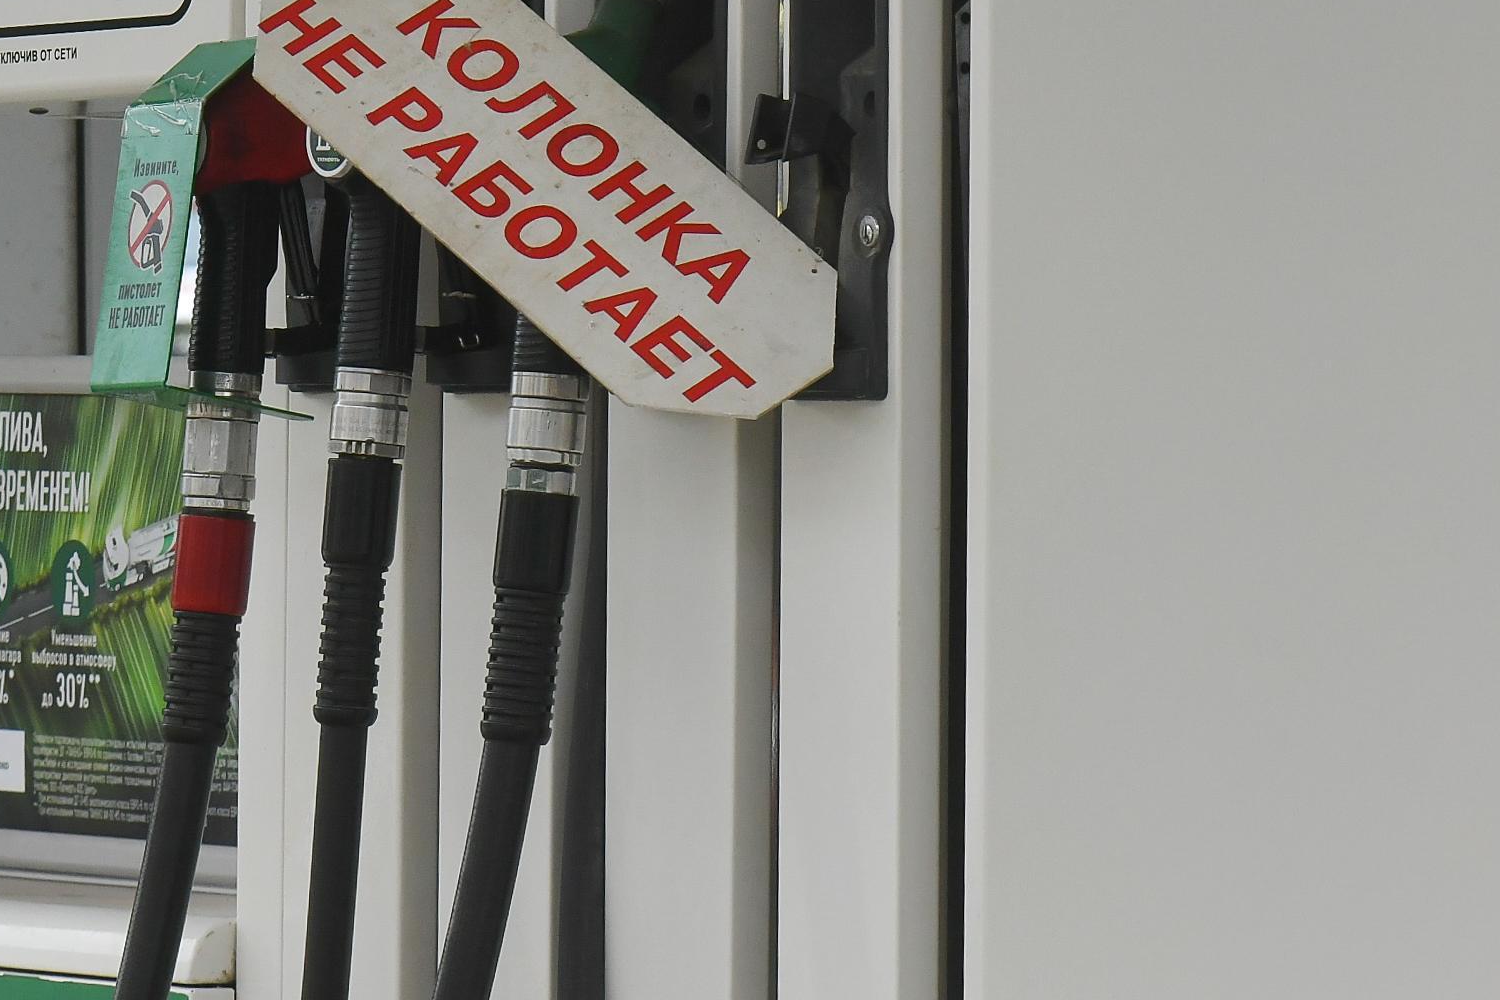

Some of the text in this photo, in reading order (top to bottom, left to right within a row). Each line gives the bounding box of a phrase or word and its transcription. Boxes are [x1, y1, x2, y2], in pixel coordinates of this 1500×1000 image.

[40, 49, 52, 61] ОТ
[54, 47, 77, 60] СЕТИ
[134, 158, 179, 177] Извините,
[365, 86, 758, 404] РАБОТАЕТ
[118, 282, 162, 299] пистолет
[108, 304, 165, 329] НЕ РАБОТАЕТ
[51, 629, 97, 648] Уменьшение
[32, 652, 67, 668] выбросов
[76, 655, 116, 671] атмосферу
[41, 693, 53, 708] до
